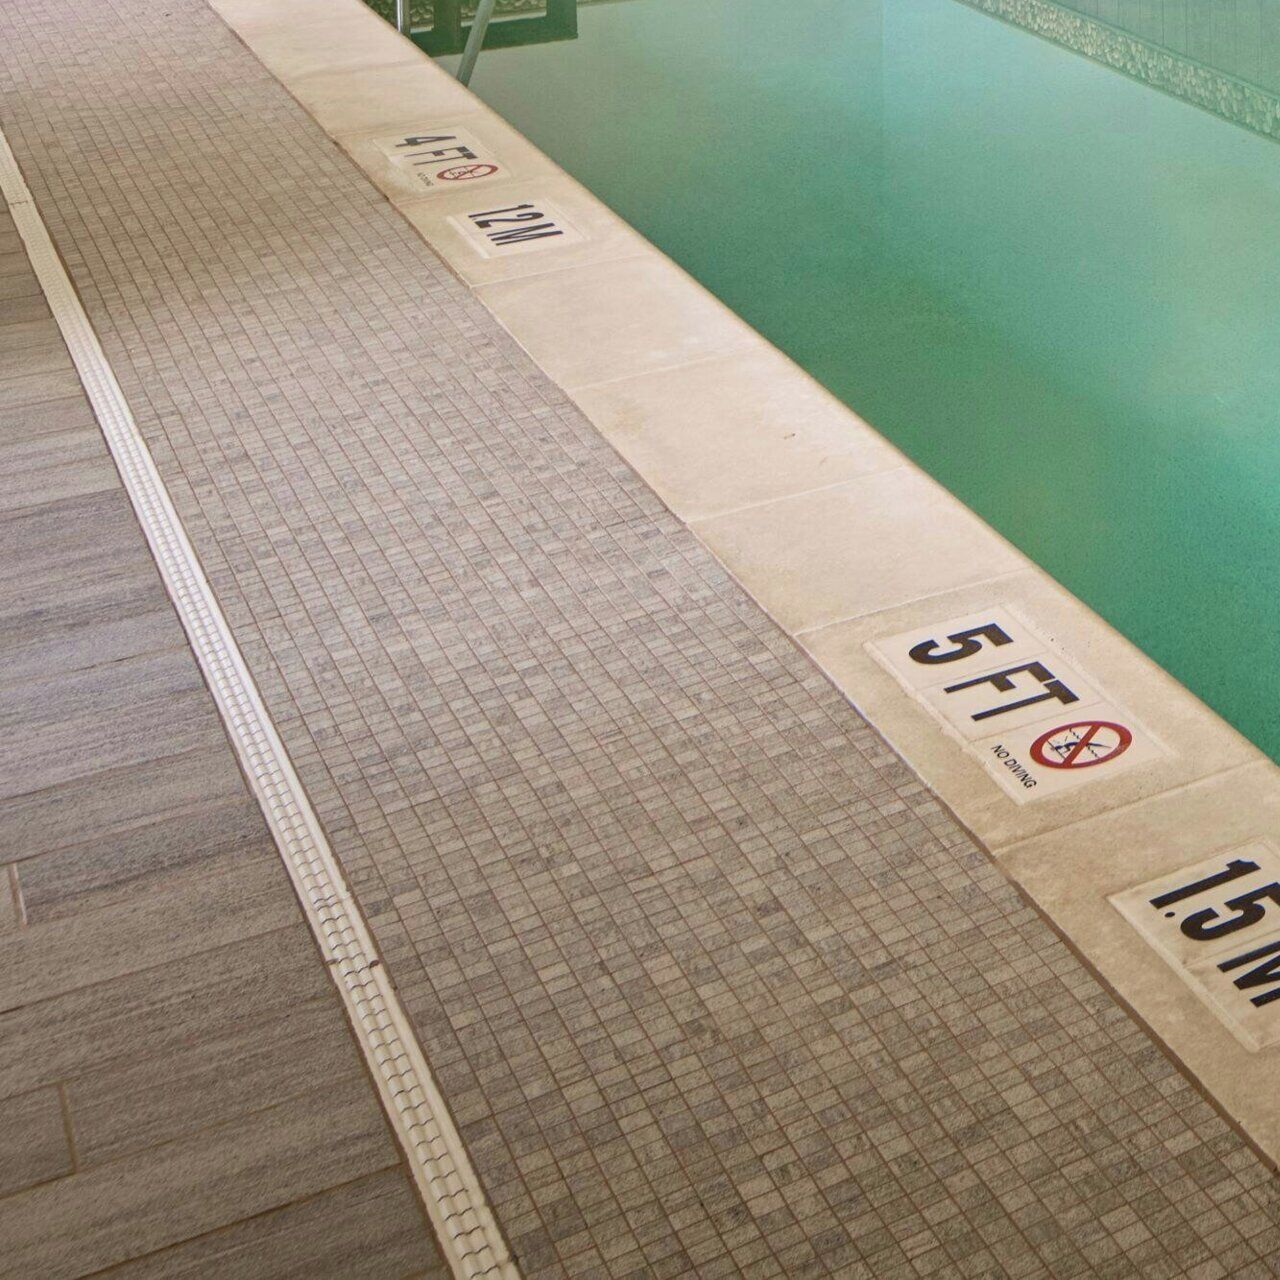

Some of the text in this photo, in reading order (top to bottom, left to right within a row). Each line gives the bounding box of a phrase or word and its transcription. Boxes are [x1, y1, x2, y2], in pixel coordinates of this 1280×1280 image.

[395, 136, 478, 166] 4 FT
[908, 622, 1080, 722] 5 FT
[990, 744, 1037, 789] NO DIVING
